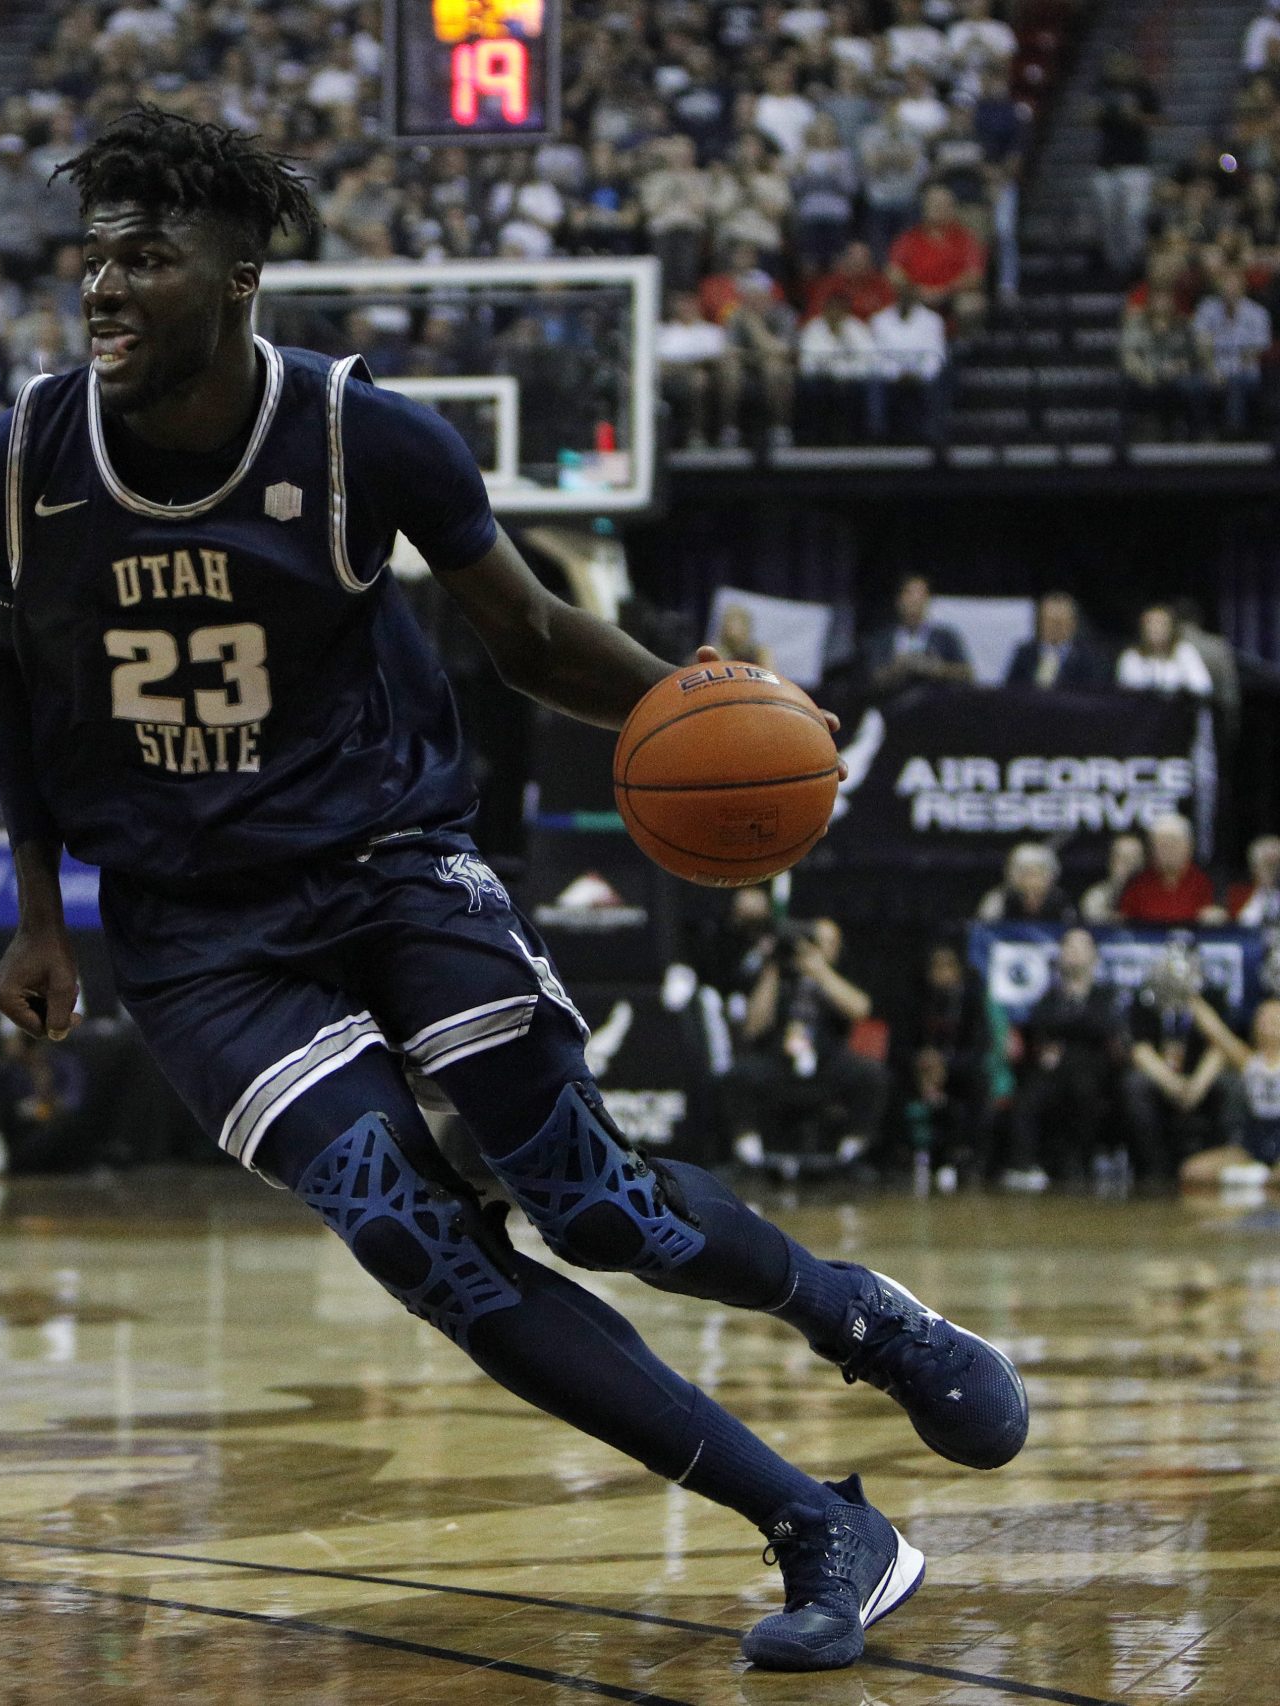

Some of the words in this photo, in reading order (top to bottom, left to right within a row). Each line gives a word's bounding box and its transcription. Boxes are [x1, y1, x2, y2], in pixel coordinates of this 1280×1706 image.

[450, 38, 530, 126] 19
[111, 548, 233, 608] UTAH
[103, 622, 272, 728] 23
[677, 666, 780, 691] ELITE
[135, 721, 261, 775] STATE
[894, 757, 1000, 796] AIR
[1006, 756, 1194, 798] FORCE
[911, 792, 1180, 832] RESERVE
